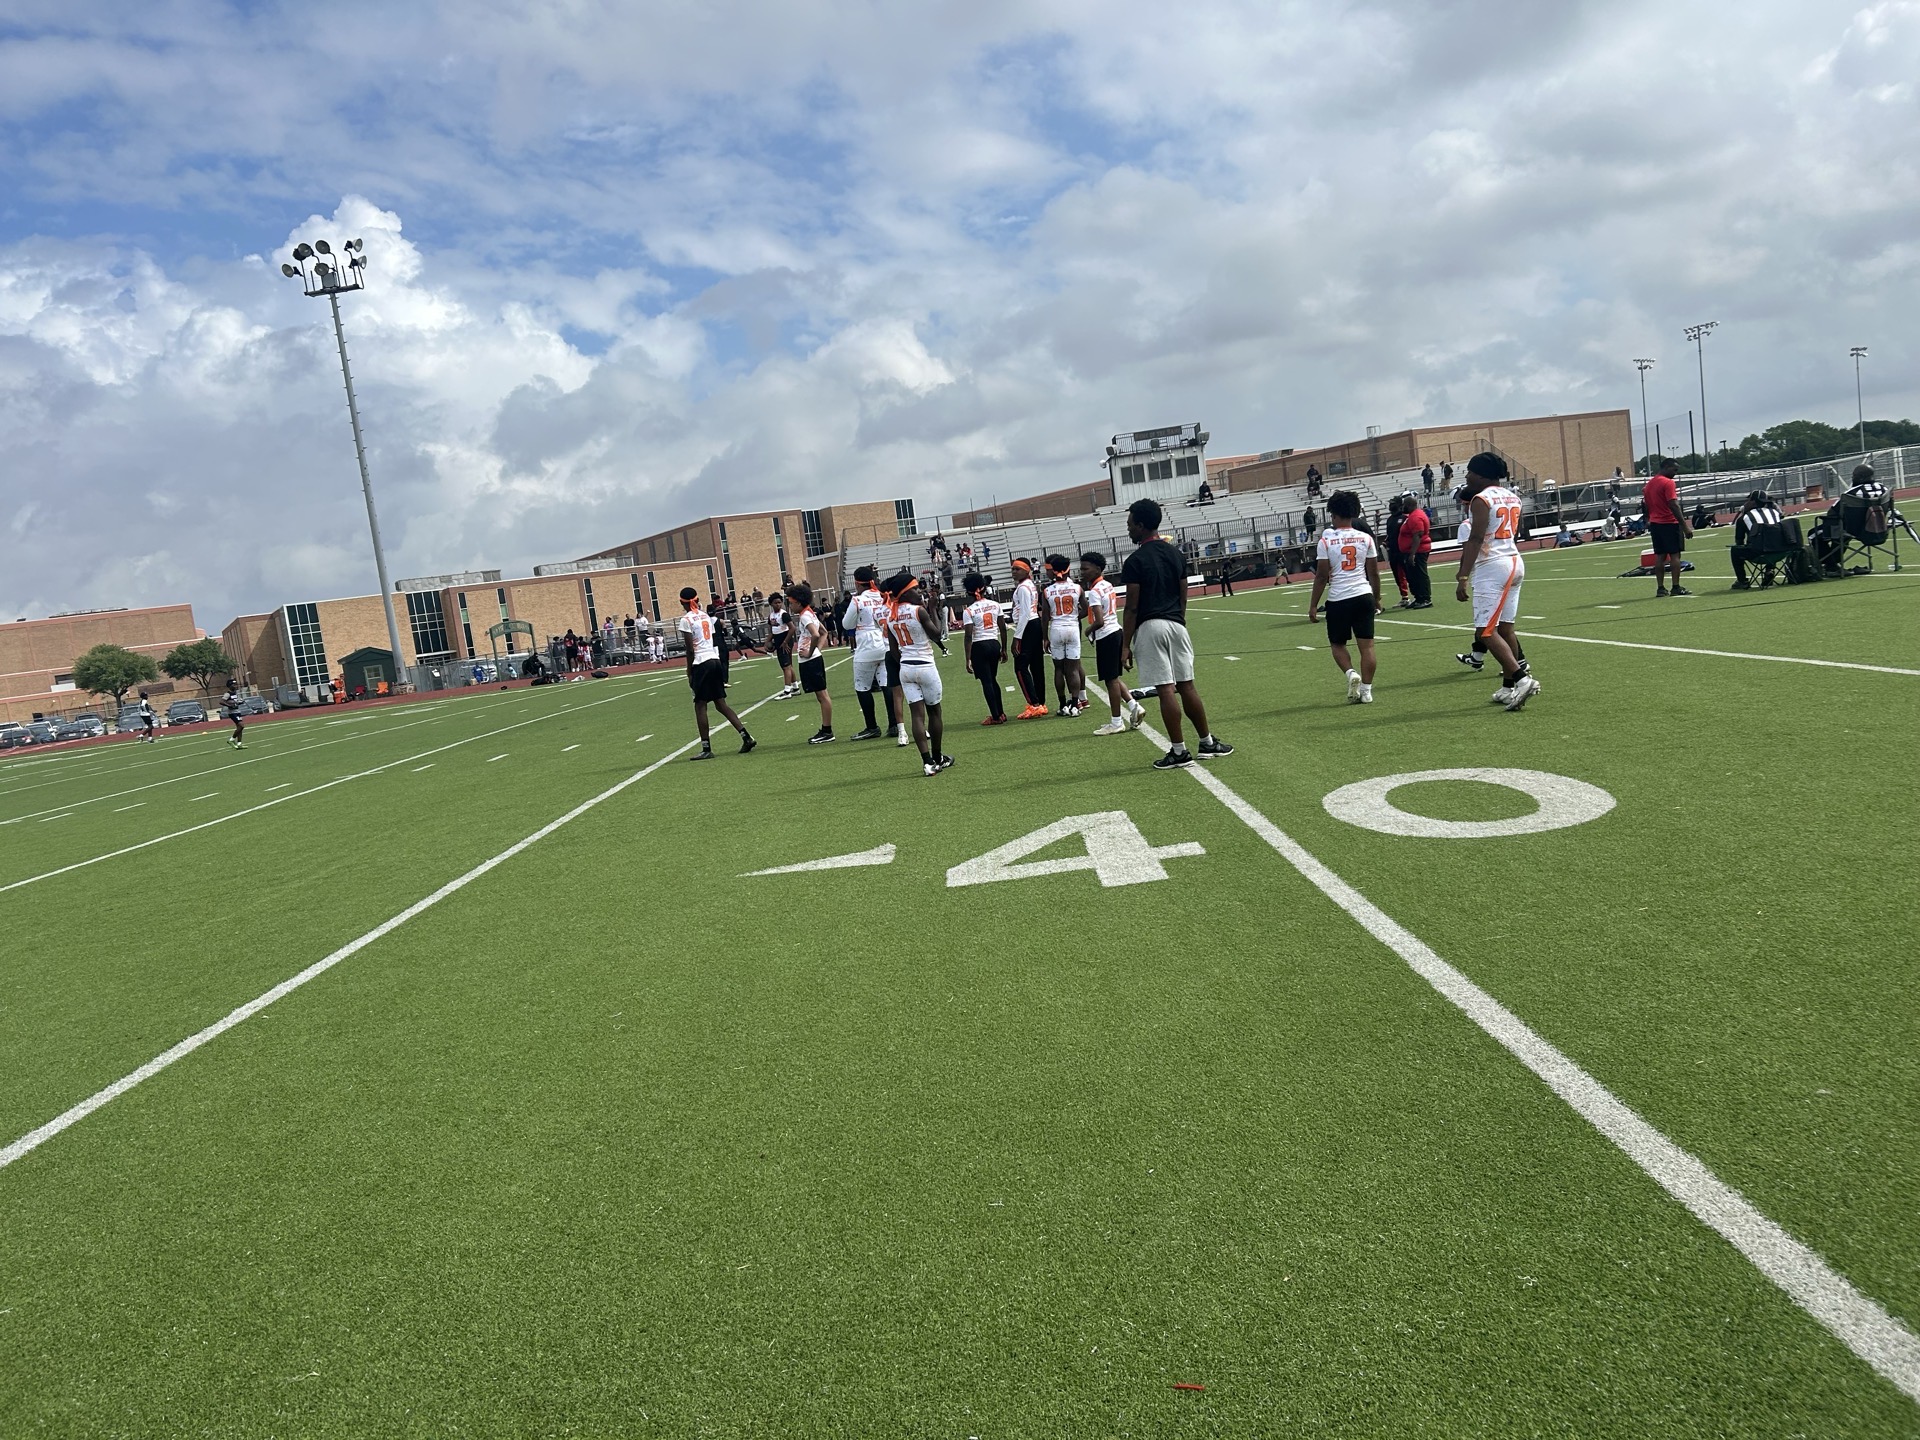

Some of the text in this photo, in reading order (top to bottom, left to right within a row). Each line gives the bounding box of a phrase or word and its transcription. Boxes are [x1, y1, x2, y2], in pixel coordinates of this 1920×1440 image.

[1340, 545, 1357, 571] 3
[1054, 595, 1074, 616] 18
[701, 620, 711, 641] 8
[893, 623, 915, 647] 11
